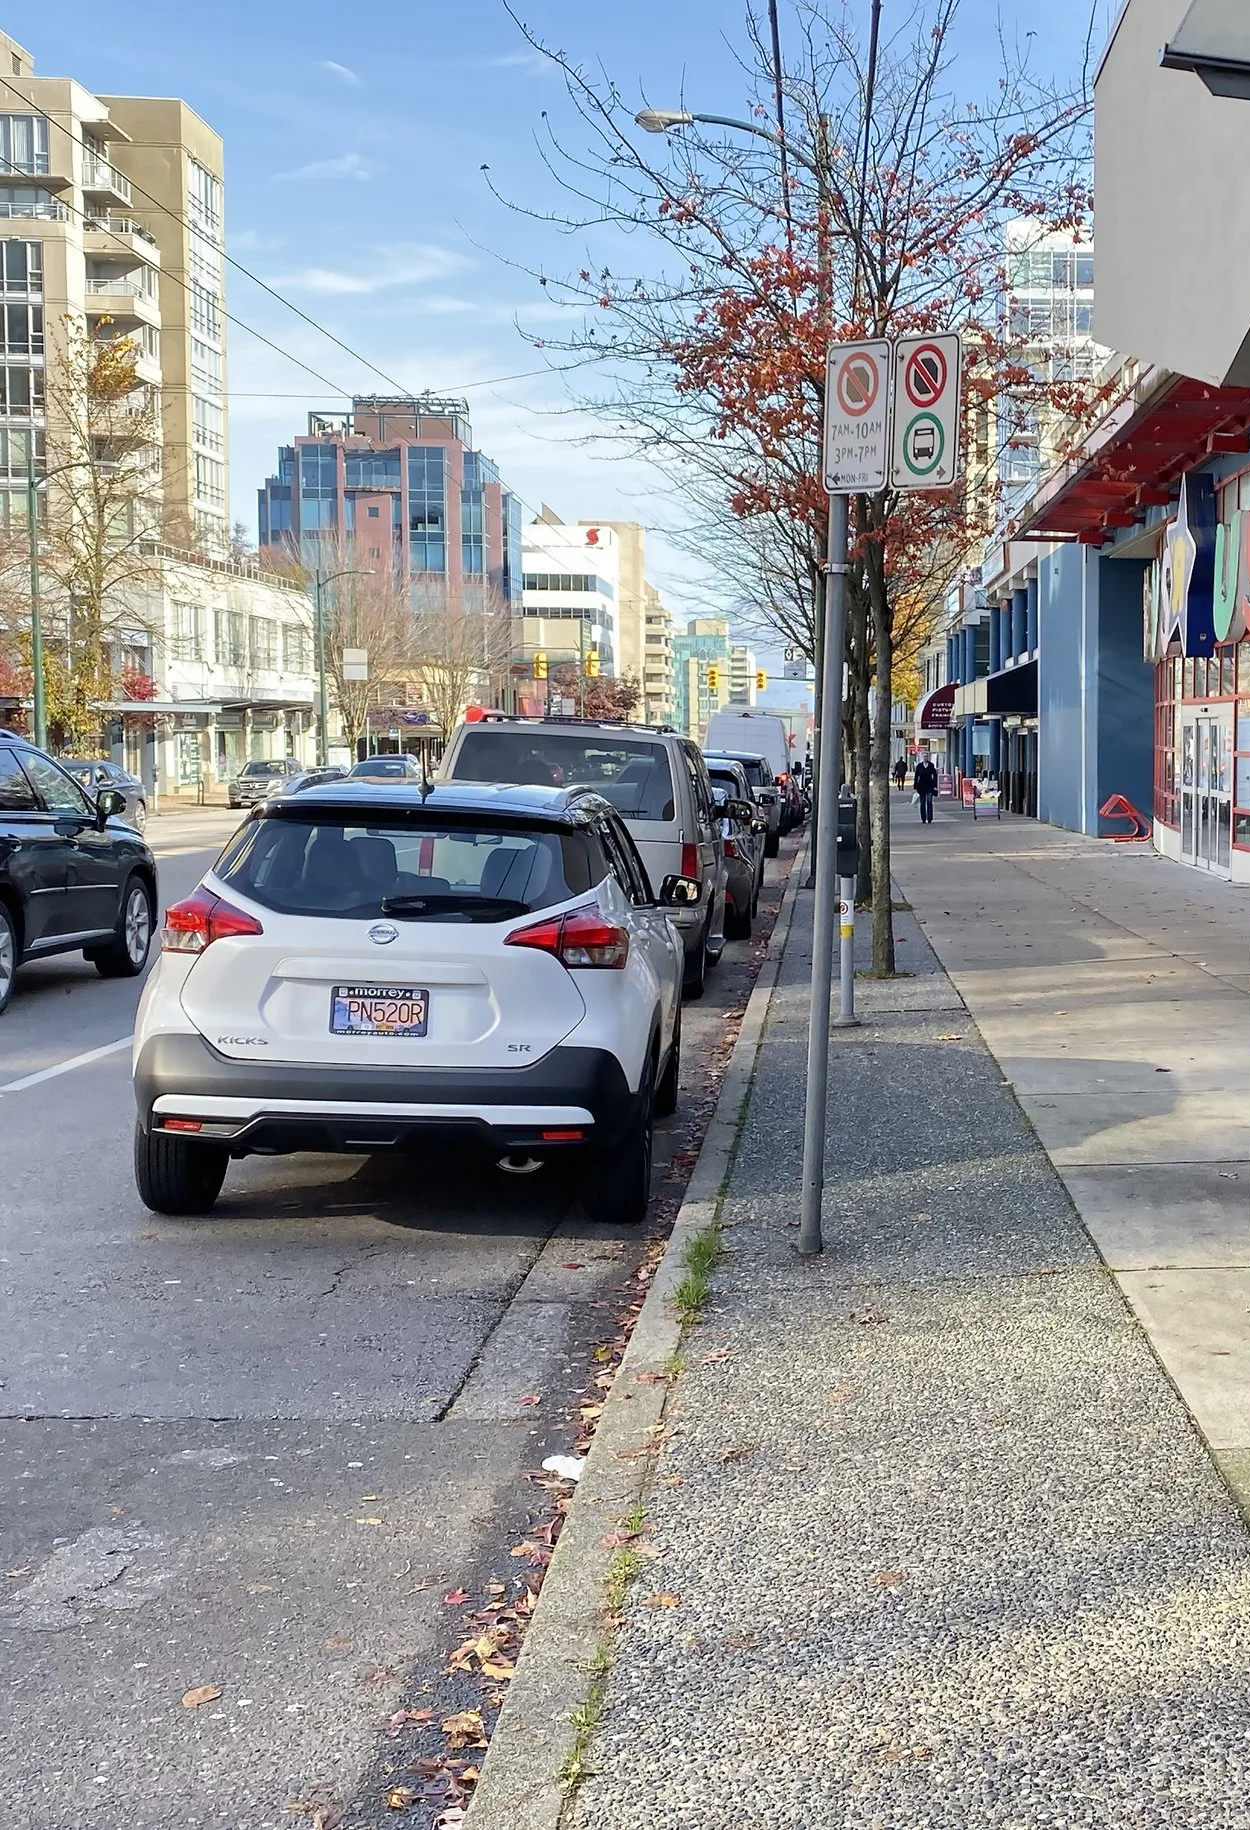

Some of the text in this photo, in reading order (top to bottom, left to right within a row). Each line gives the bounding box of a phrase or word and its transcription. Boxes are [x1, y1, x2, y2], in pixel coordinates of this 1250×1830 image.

[831, 421, 882, 442] 7AM-10AM
[834, 445, 877, 464] 3PM-7PM
[840, 473, 869, 483] MON-FRI
[354, 987, 405, 999] morrey
[348, 1001, 423, 1025] PN520R
[217, 1035, 269, 1046] KICKS
[507, 1044, 532, 1053] SR
